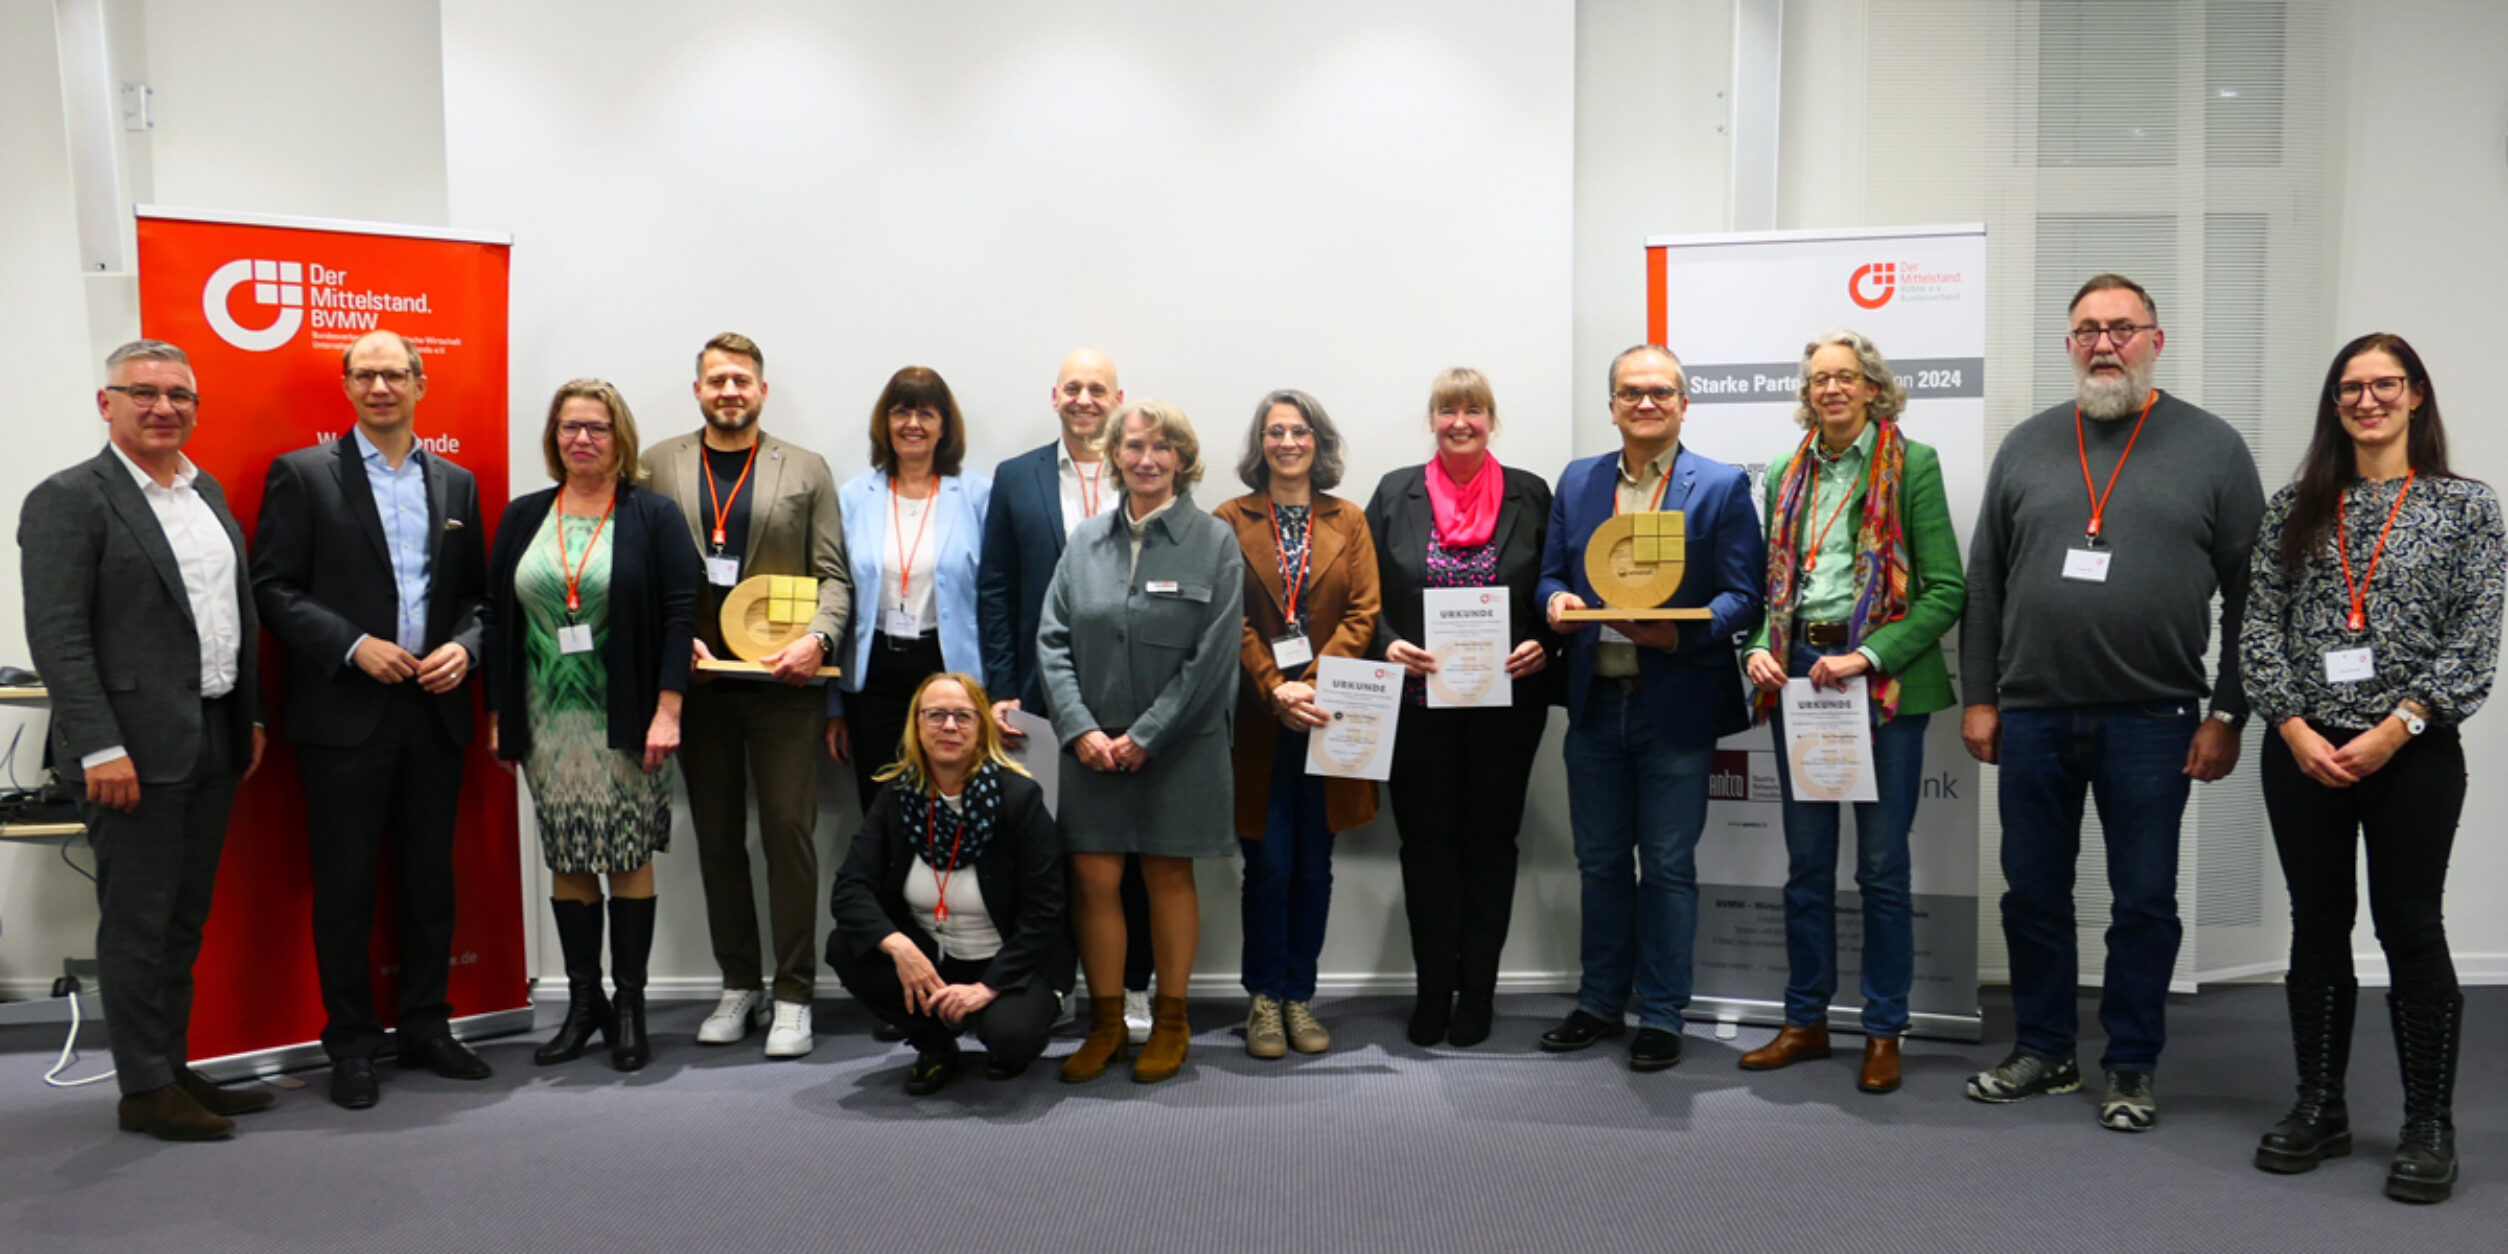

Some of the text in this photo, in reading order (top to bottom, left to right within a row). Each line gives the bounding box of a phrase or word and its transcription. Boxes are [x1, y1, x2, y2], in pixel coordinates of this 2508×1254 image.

[309, 263, 347, 286] Der
[310, 286, 433, 314] Mittelstand.
[311, 309, 379, 331] BVMW
[1690, 375, 1750, 394] Starke
[1917, 369, 1962, 389] 2024
[1440, 609, 1494, 619] URKUNDE
[1333, 679, 1387, 693] URKUNDE
[1797, 699, 1852, 710] URKUNDE
